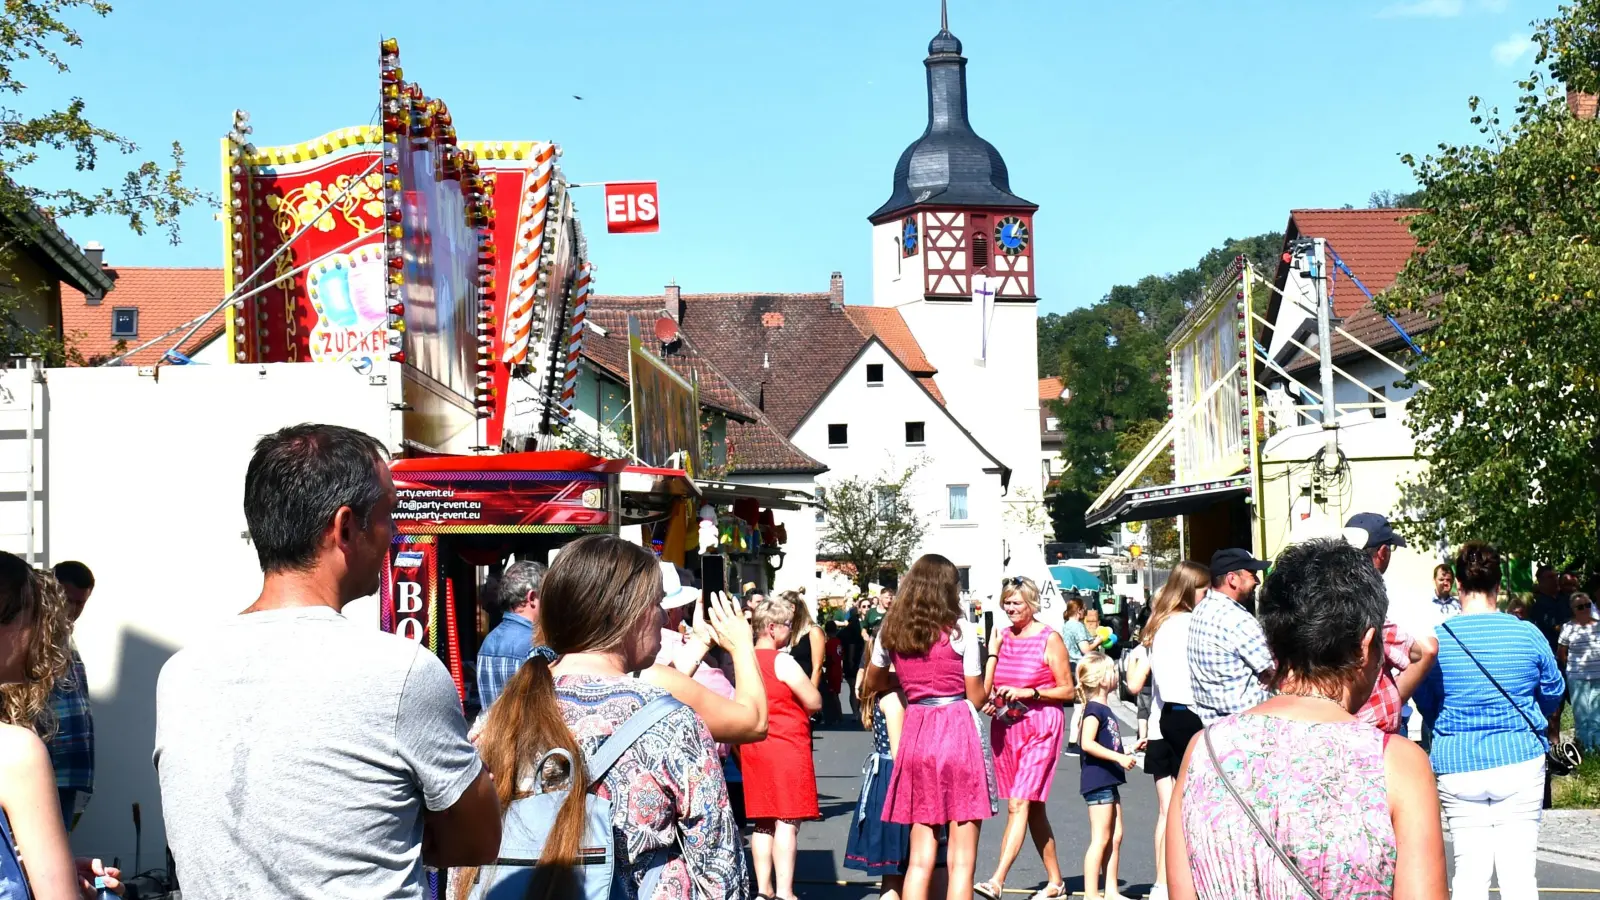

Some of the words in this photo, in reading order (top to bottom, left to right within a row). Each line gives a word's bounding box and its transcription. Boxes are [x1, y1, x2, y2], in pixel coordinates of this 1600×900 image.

[607, 193, 657, 222] EIS
[396, 489, 454, 499] arty.event.eu
[397, 500, 481, 511] fo@party-event.eu
